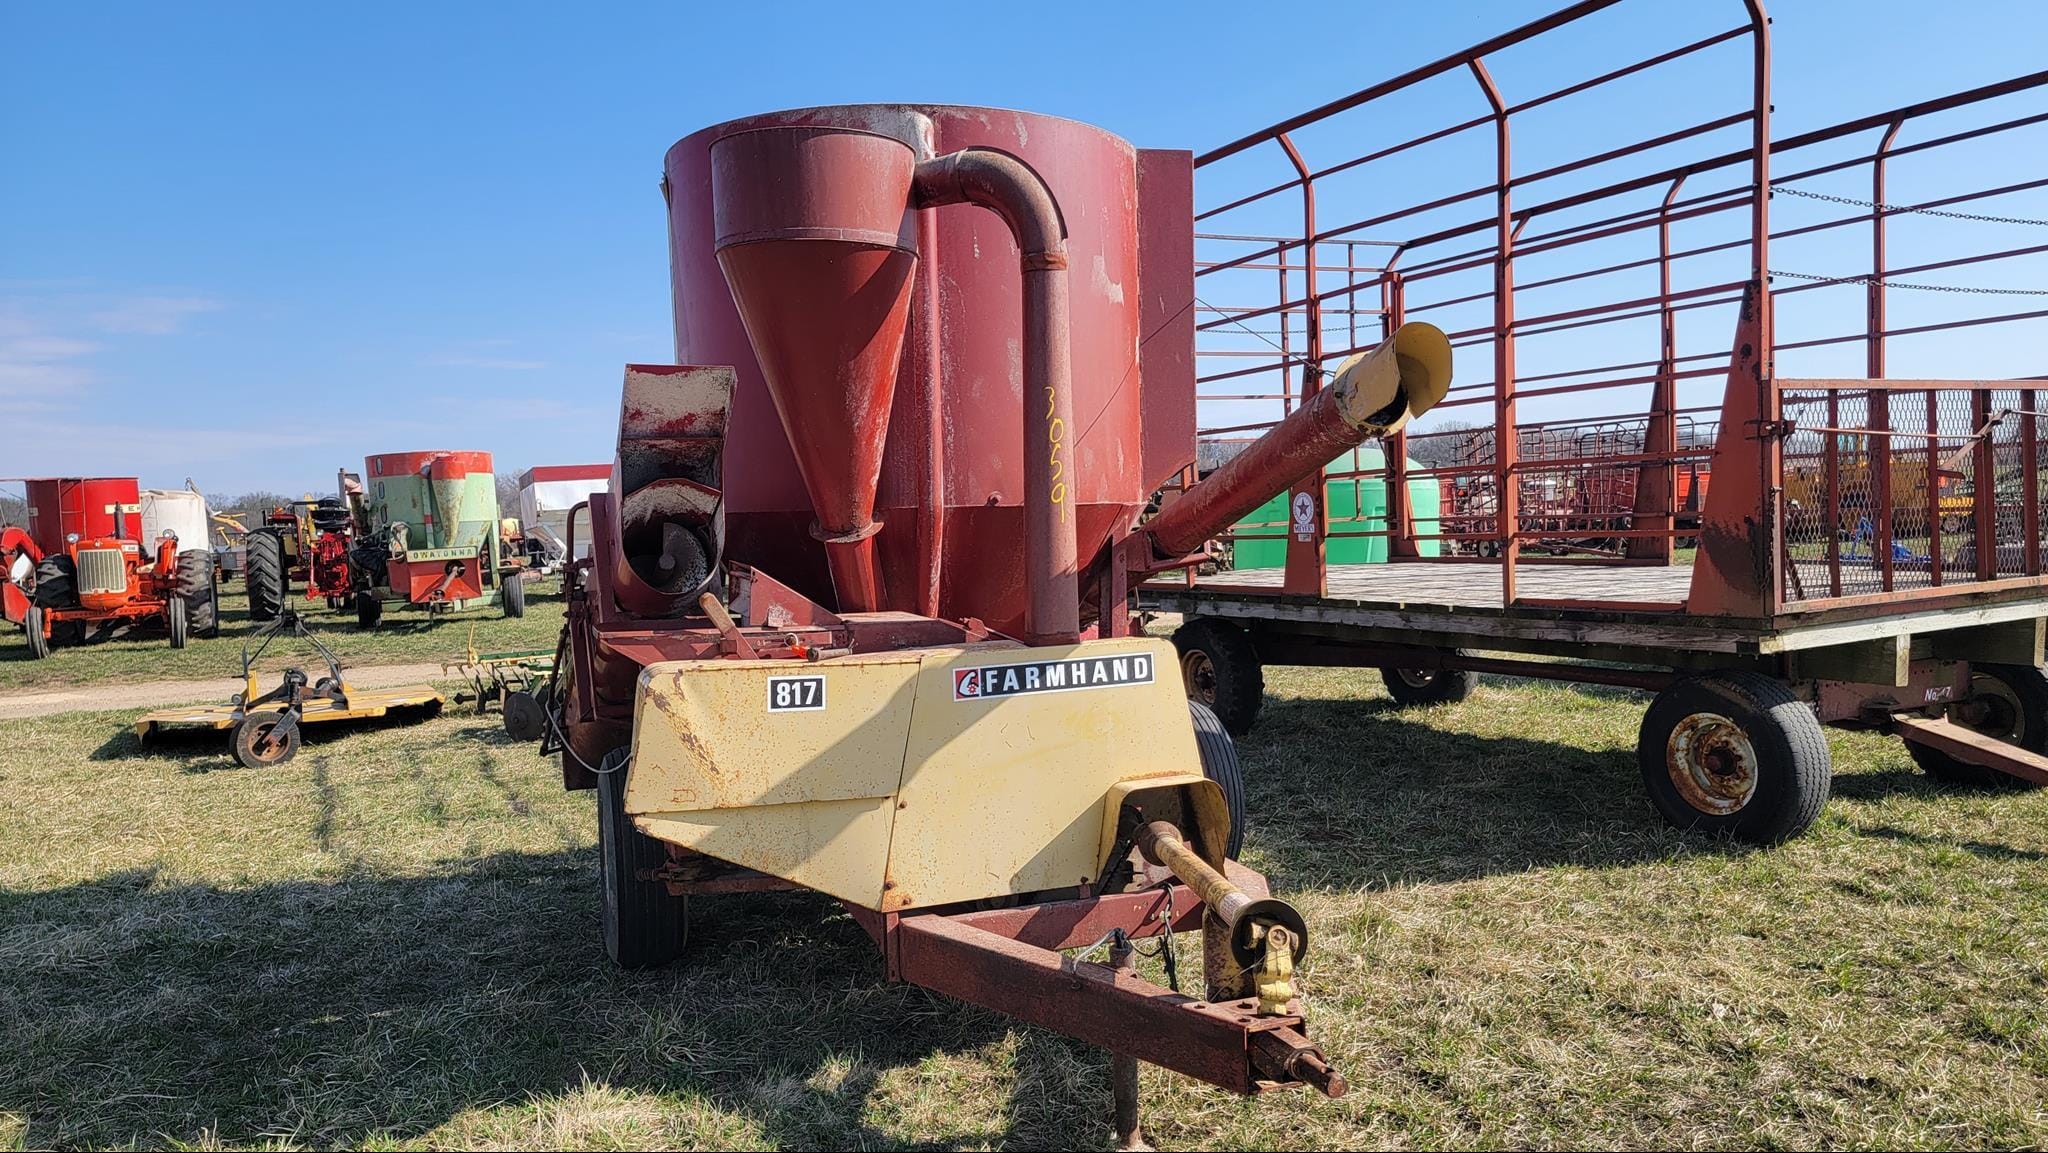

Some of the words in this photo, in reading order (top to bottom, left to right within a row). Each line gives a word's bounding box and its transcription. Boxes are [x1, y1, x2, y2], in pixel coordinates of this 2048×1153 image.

[1042, 386, 1067, 524] 3059
[413, 549, 473, 560] OWATONNA
[985, 657, 1149, 693] FARMHAND
[776, 681, 817, 706] 817
